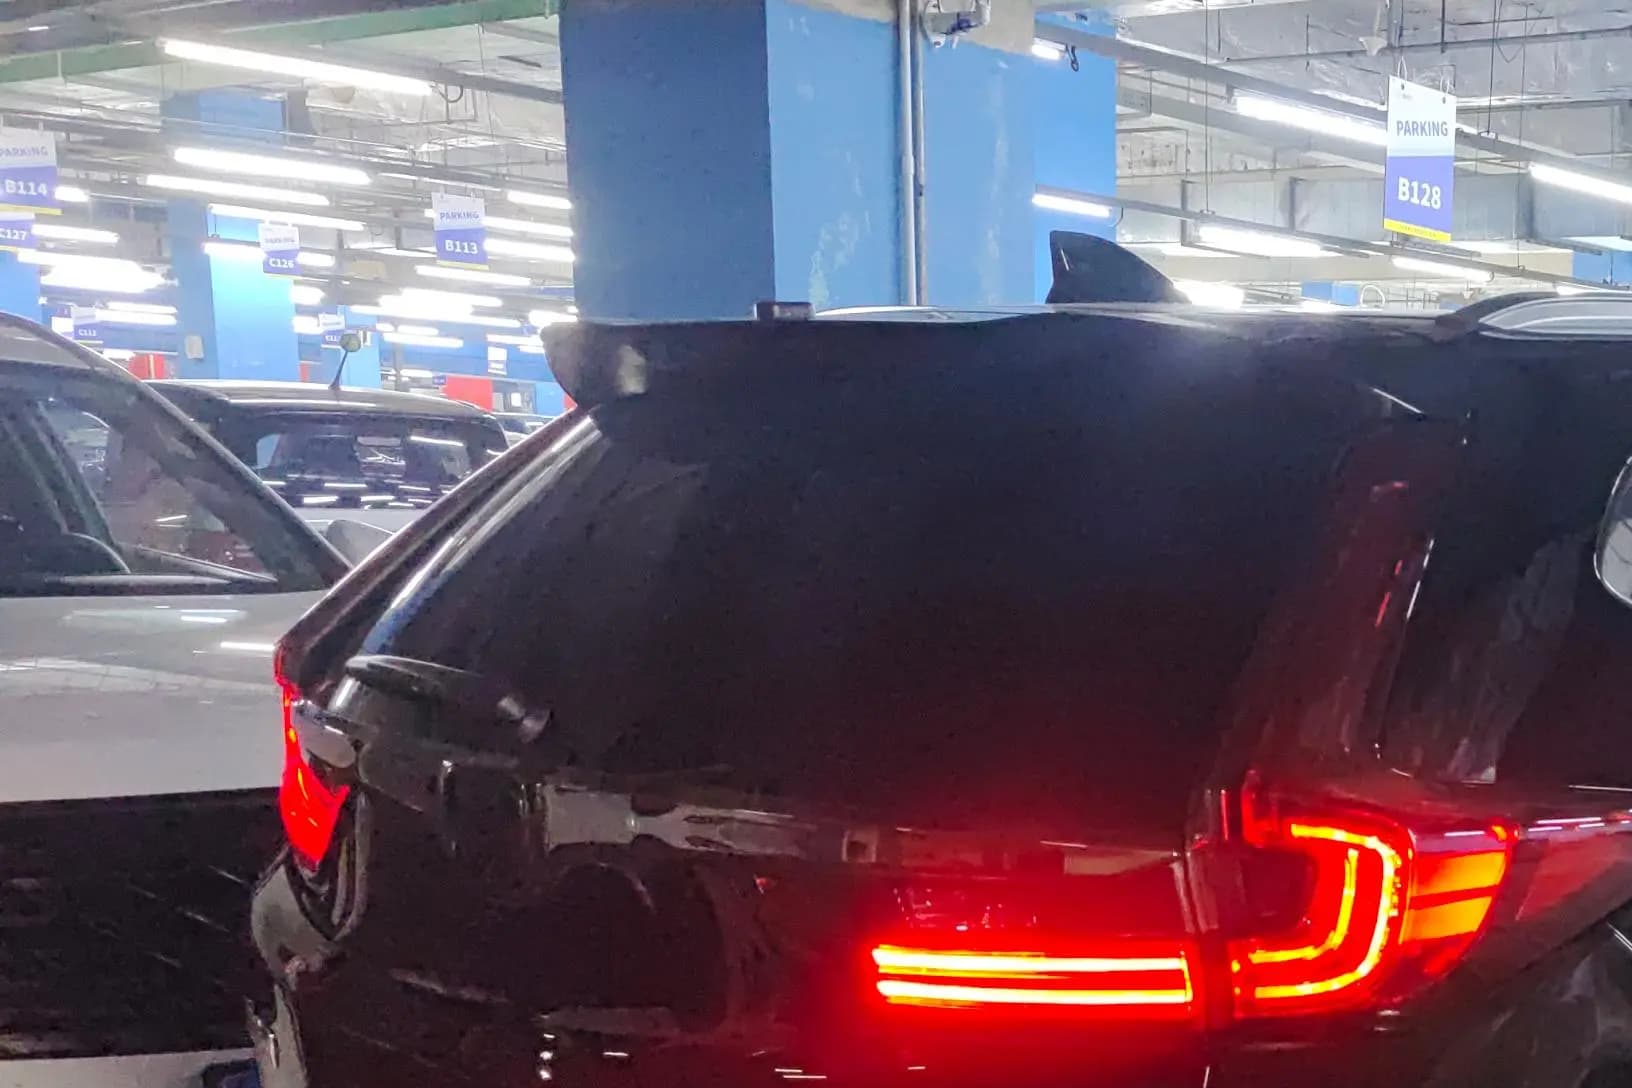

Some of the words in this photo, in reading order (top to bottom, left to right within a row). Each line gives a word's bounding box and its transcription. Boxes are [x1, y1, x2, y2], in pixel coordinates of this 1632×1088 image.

[1396, 120, 1448, 137] PARKING
[5, 180, 48, 196] B114
[1398, 177, 1441, 209] B128
[440, 211, 480, 220] PARKING
[445, 240, 478, 254] B113
